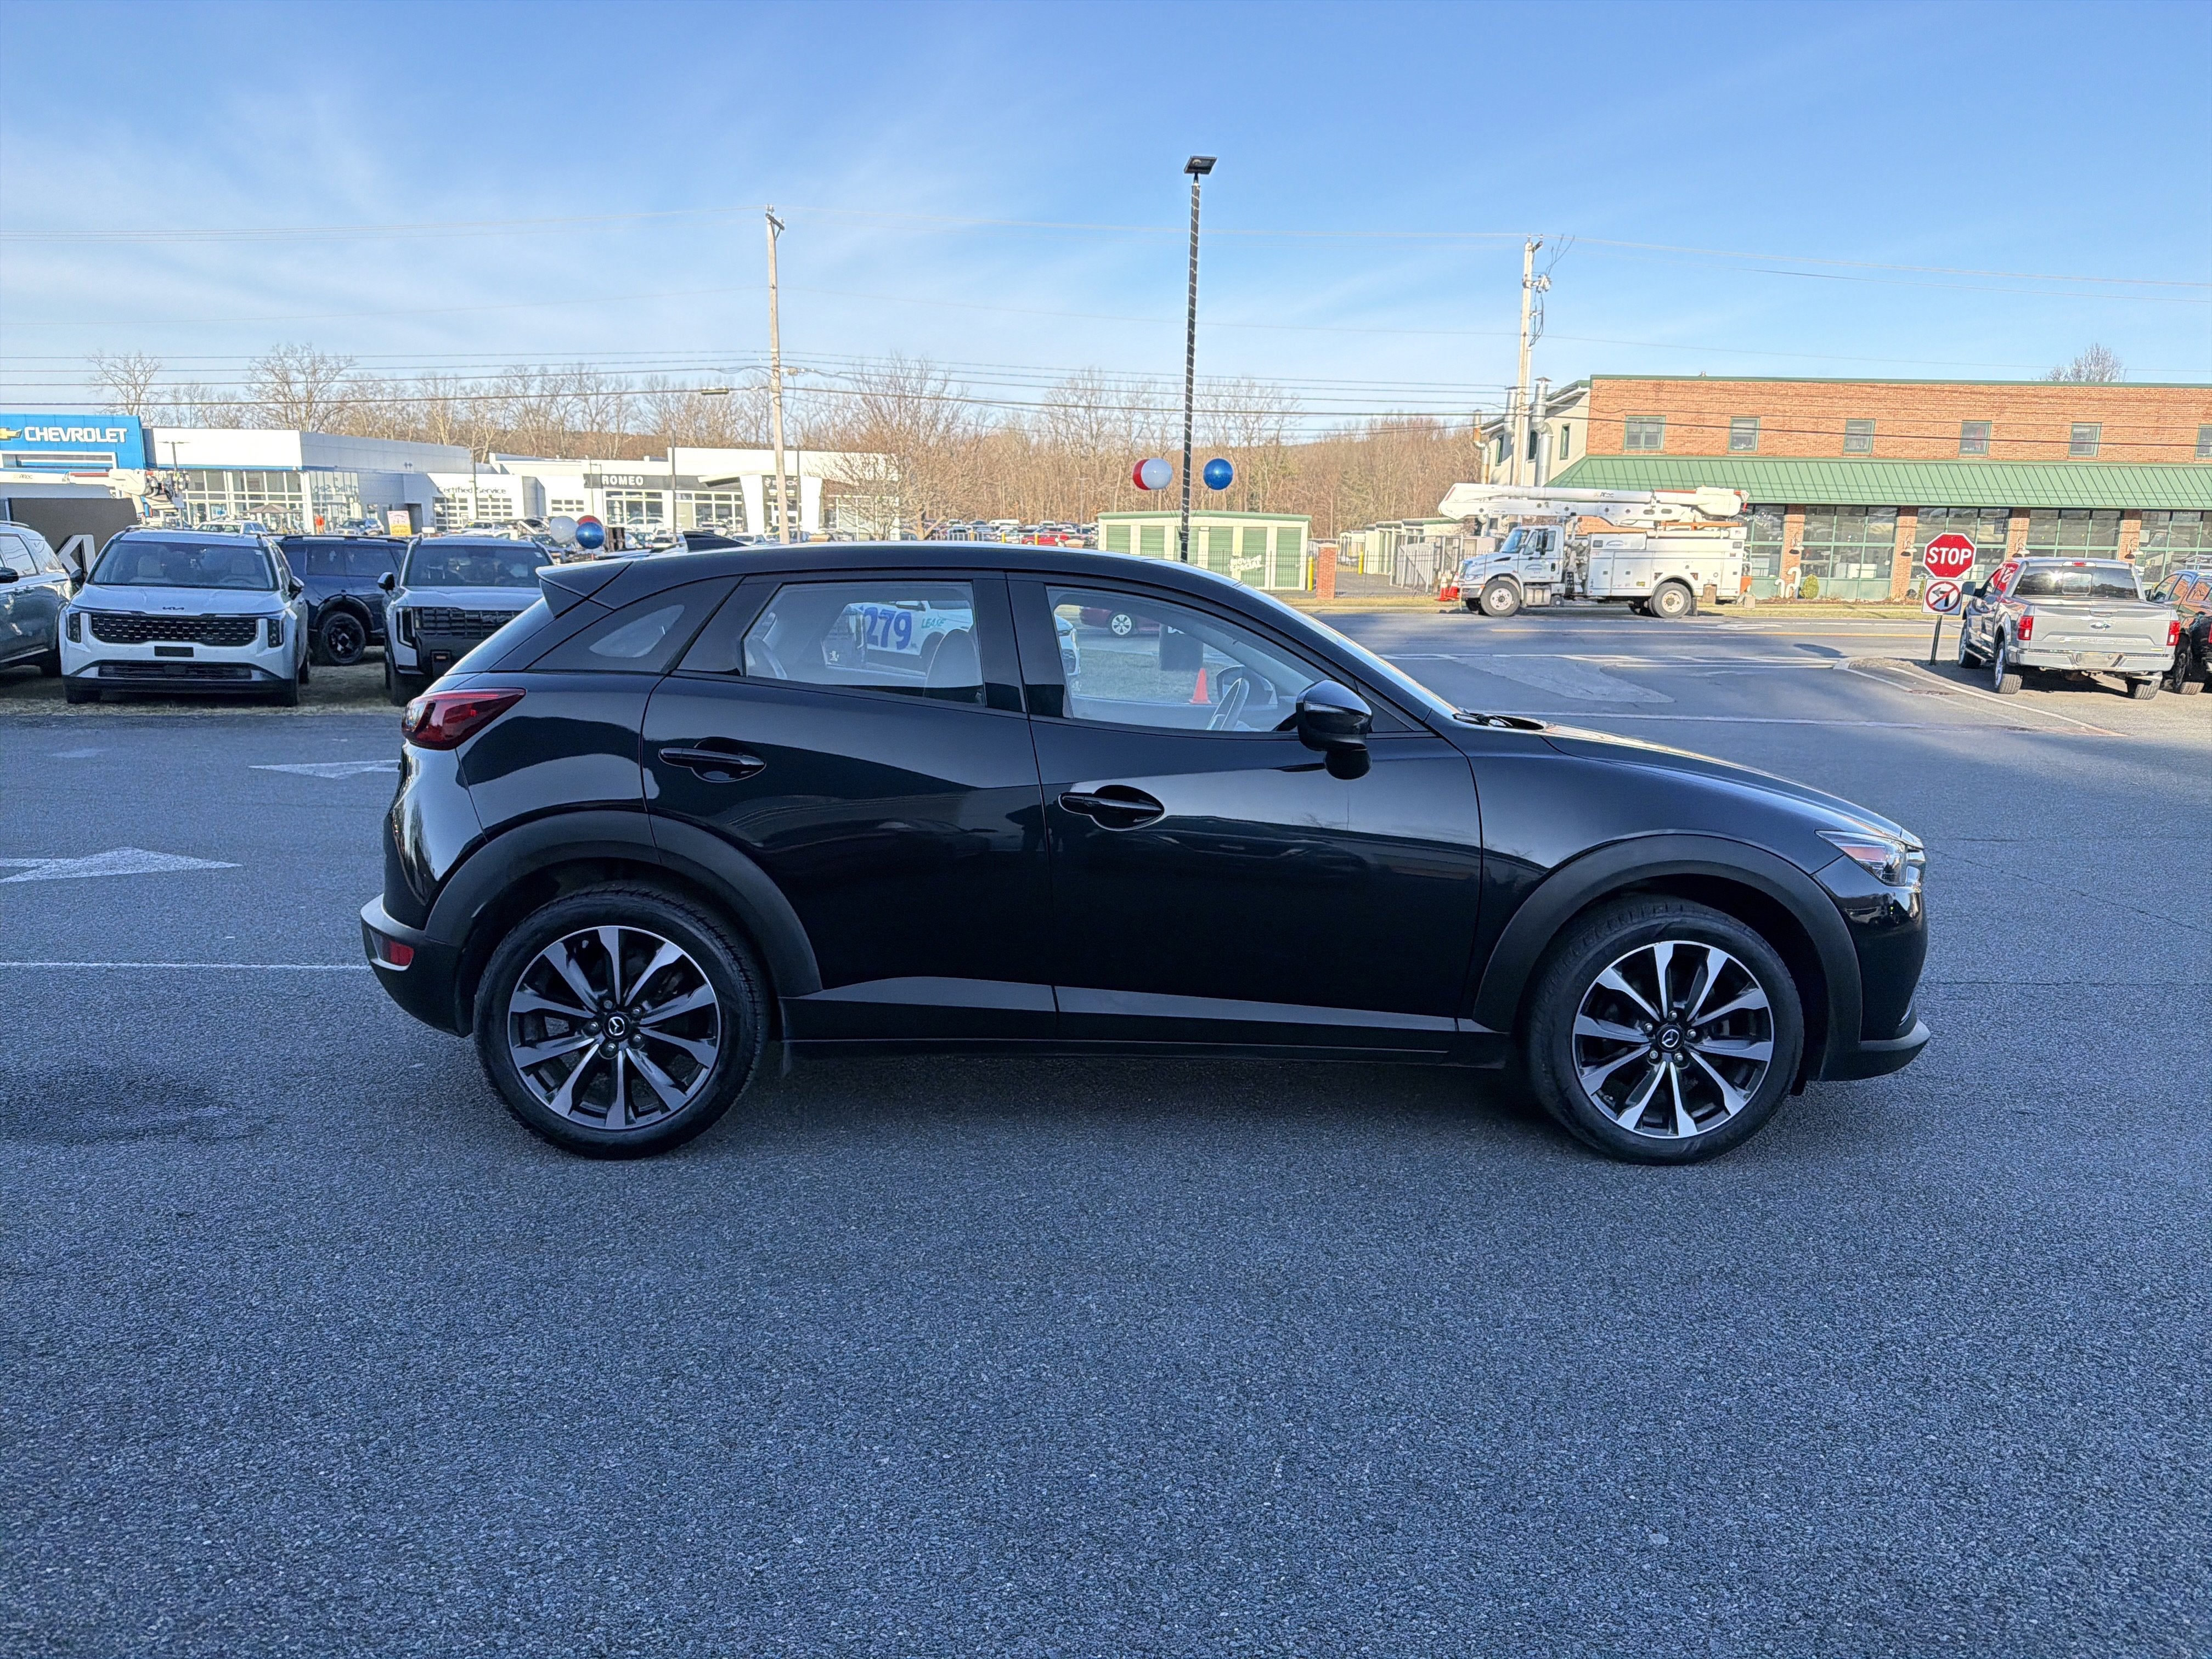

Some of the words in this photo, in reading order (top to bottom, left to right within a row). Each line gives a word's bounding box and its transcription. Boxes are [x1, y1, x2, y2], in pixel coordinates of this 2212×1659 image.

[24, 426, 127, 443] CHEVROLET
[601, 475, 644, 486] ROMEO
[1927, 546, 1972, 565] STOP
[921, 618, 946, 629] LEASE
